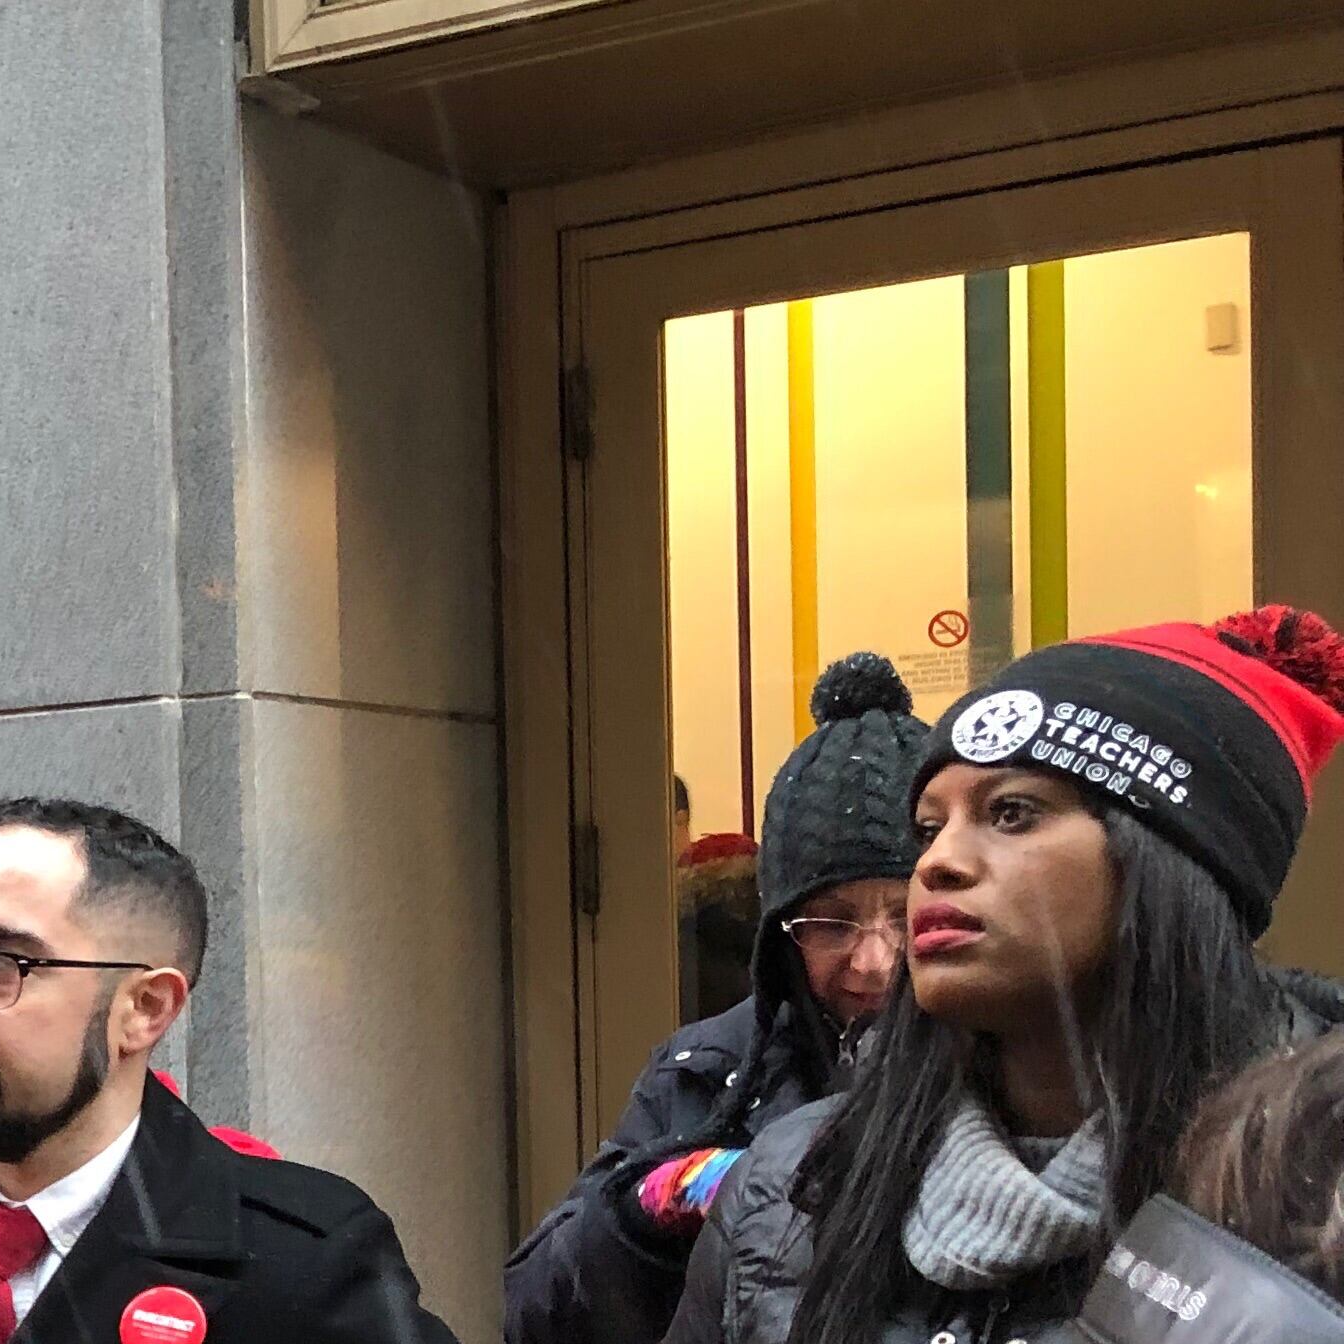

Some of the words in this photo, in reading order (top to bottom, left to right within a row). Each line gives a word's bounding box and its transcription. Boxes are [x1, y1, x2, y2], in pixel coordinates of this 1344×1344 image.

[1031, 739, 1132, 795] UNION
[1046, 718, 1188, 804] TEACHERS
[1054, 702, 1192, 779] CHICAGO
